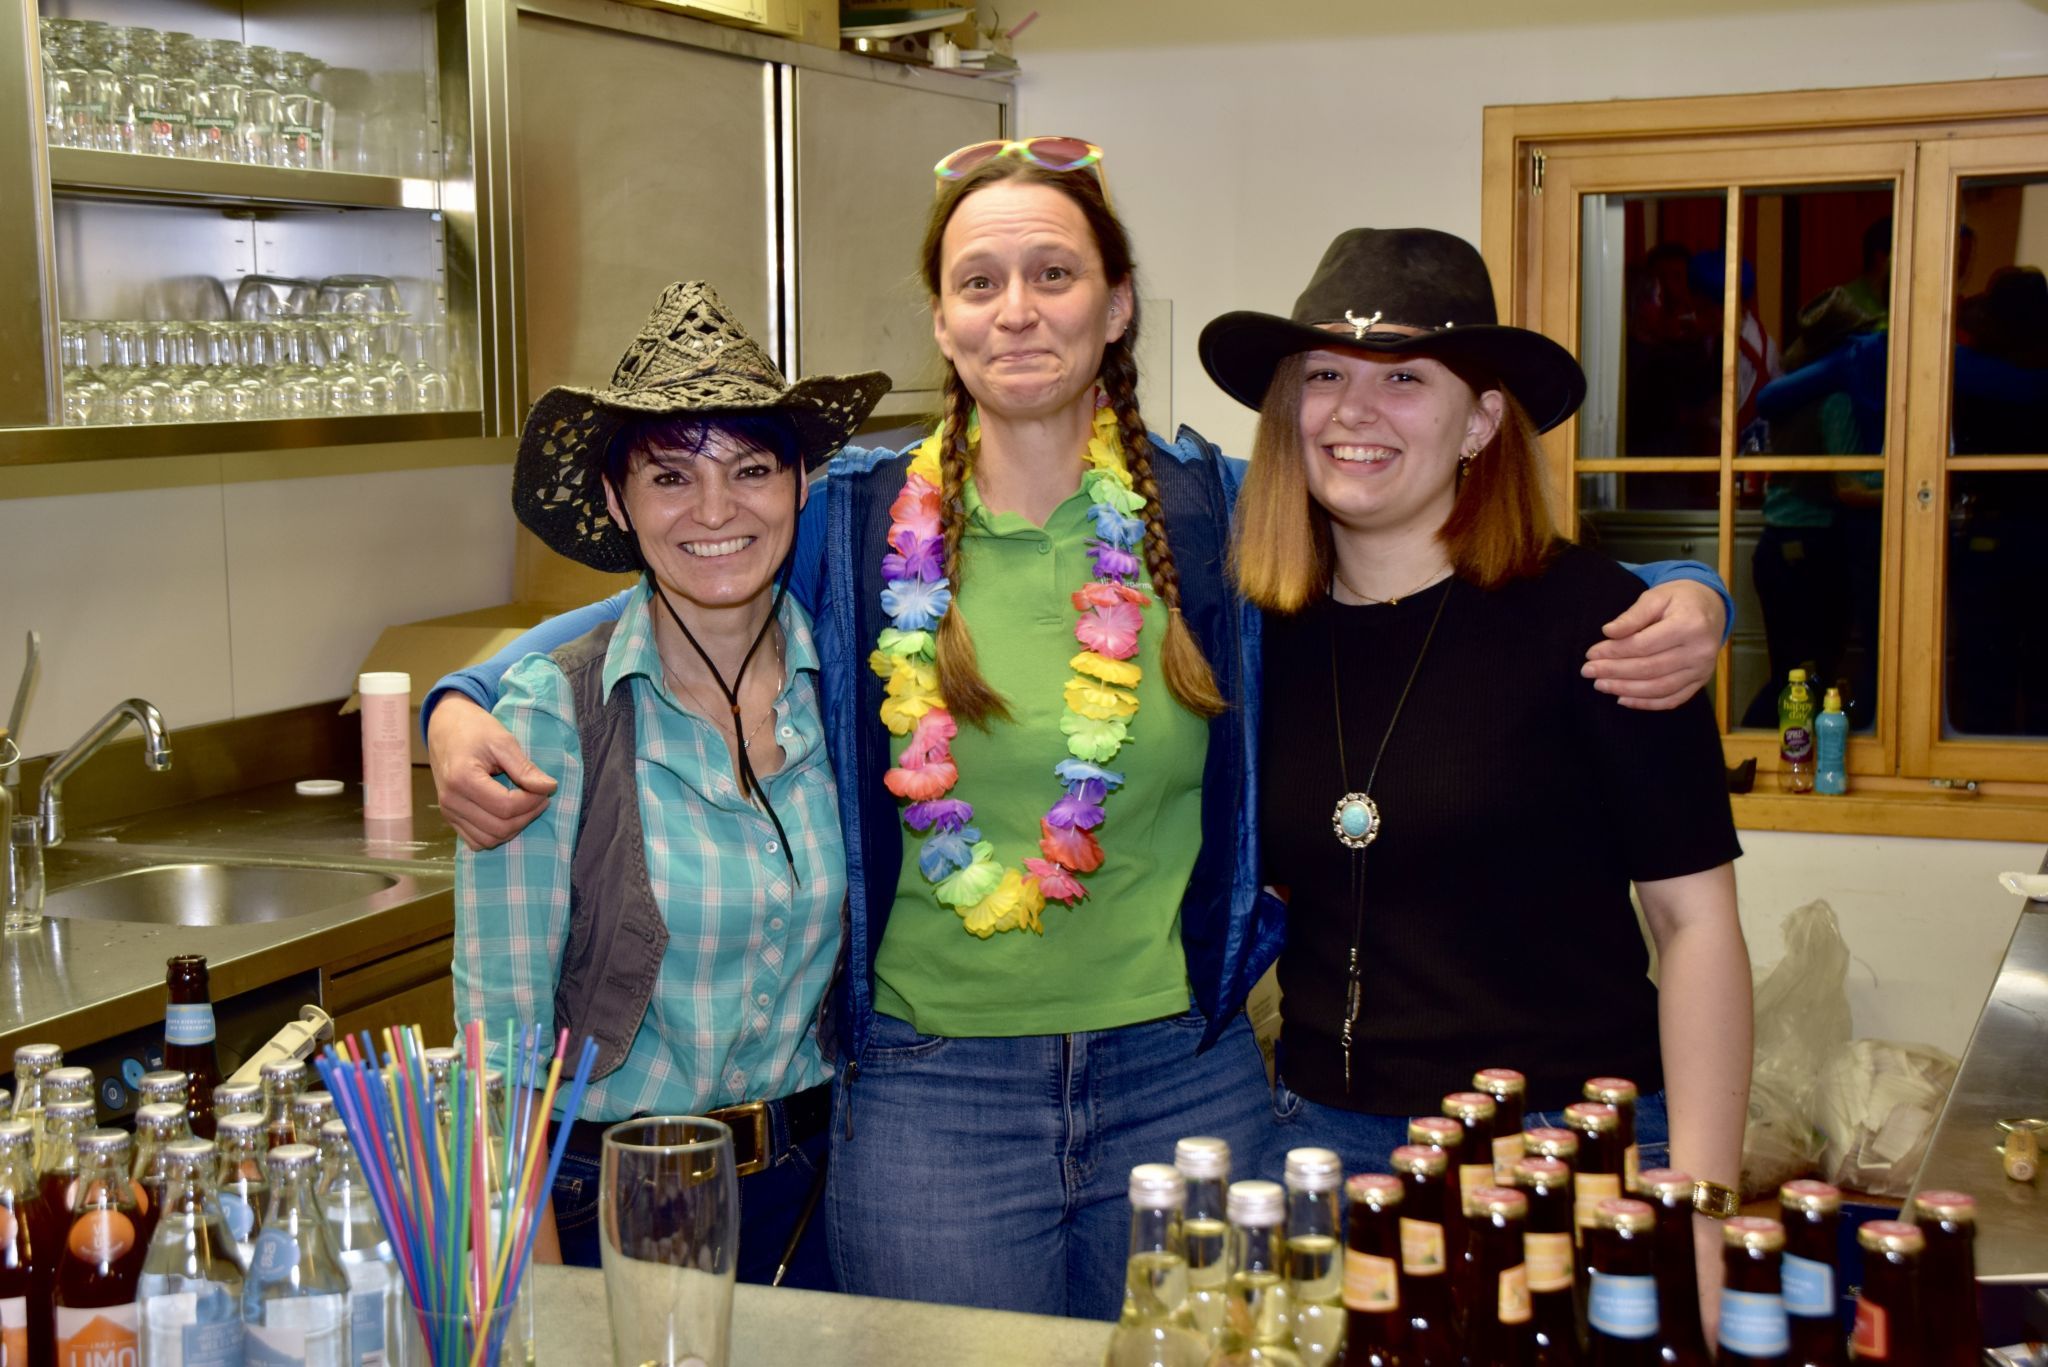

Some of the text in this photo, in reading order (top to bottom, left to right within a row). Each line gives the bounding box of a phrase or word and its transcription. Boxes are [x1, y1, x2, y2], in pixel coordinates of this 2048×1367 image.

[1783, 699, 1813, 713] happy
[1788, 710, 1808, 721] day
[70, 1347, 137, 1367] LIMO
